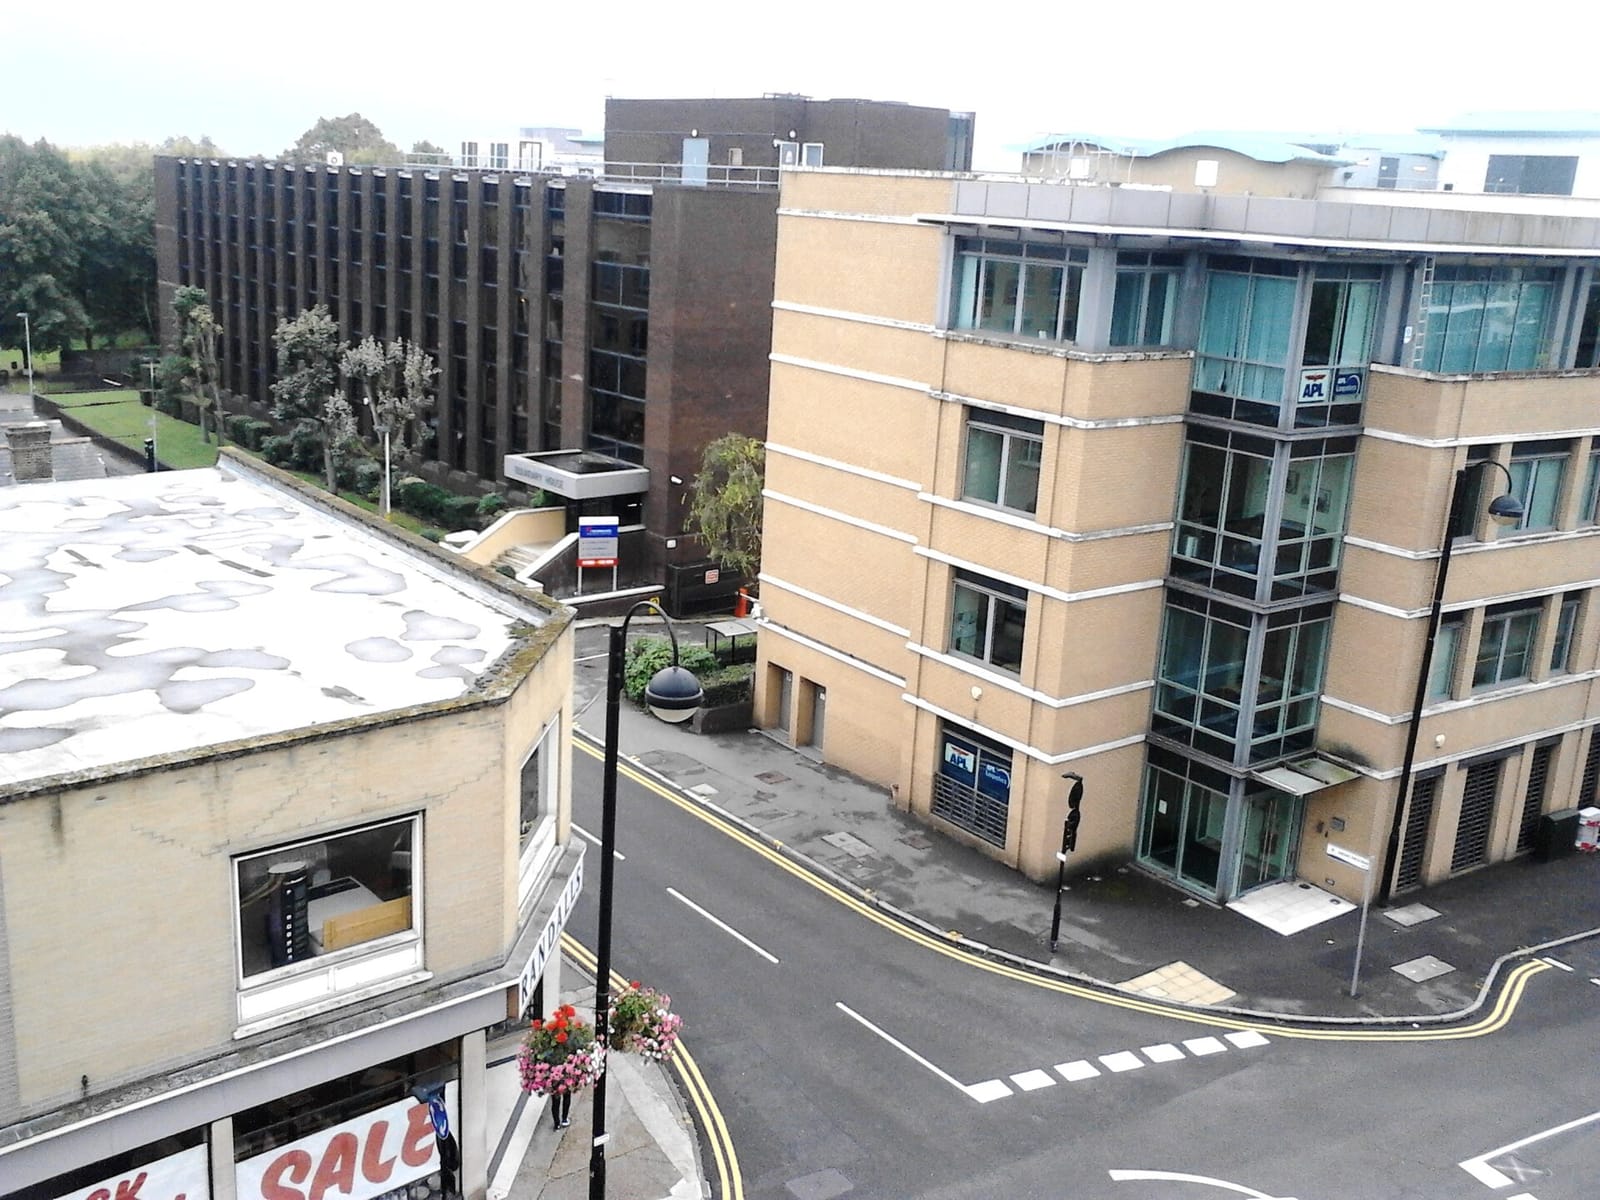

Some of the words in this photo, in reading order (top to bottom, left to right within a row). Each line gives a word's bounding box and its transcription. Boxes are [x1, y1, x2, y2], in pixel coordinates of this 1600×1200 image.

[1302, 383, 1324, 398] APL
[950, 753, 969, 770] APL
[521, 865, 582, 1004] RANDALLS
[261, 1102, 438, 1200] SALE
